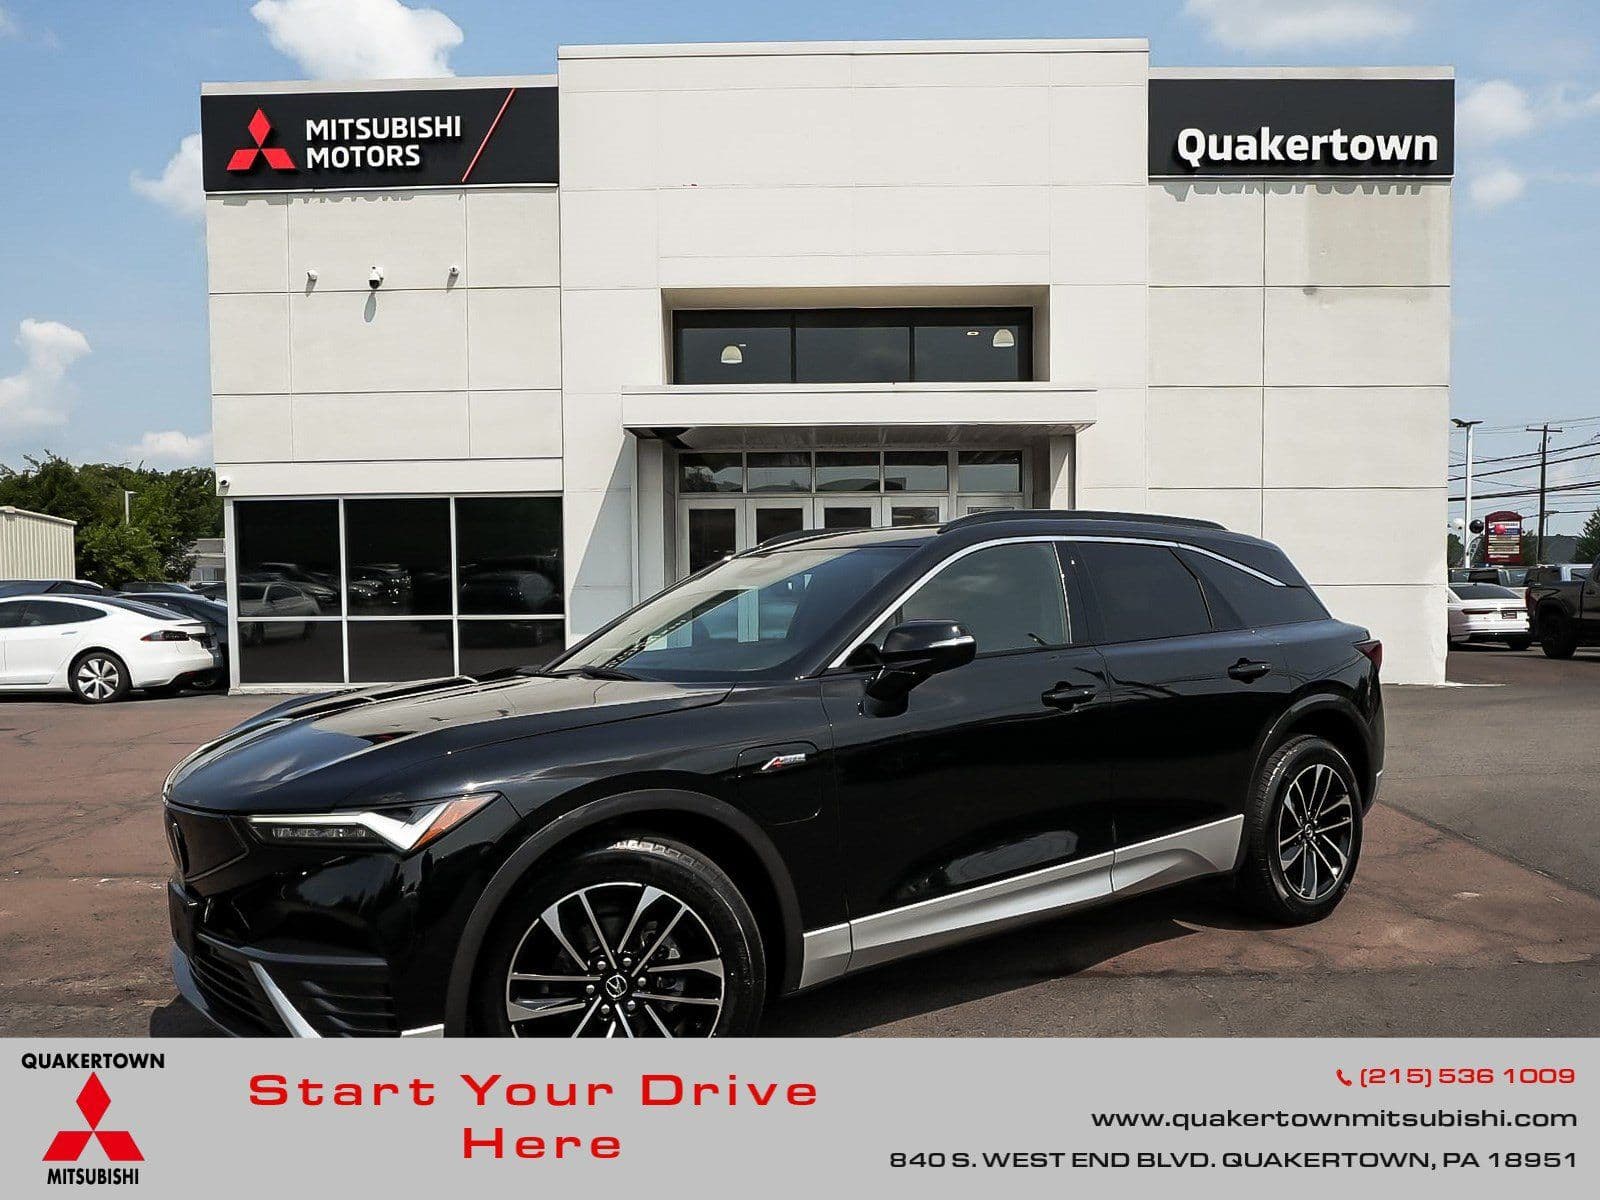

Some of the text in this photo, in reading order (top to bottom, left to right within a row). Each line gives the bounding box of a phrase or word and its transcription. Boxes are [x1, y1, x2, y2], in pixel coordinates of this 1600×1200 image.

[306, 116, 461, 141] MITSUBISHI
[306, 144, 420, 169] MOTORS
[1177, 126, 1438, 168] Quakertown
